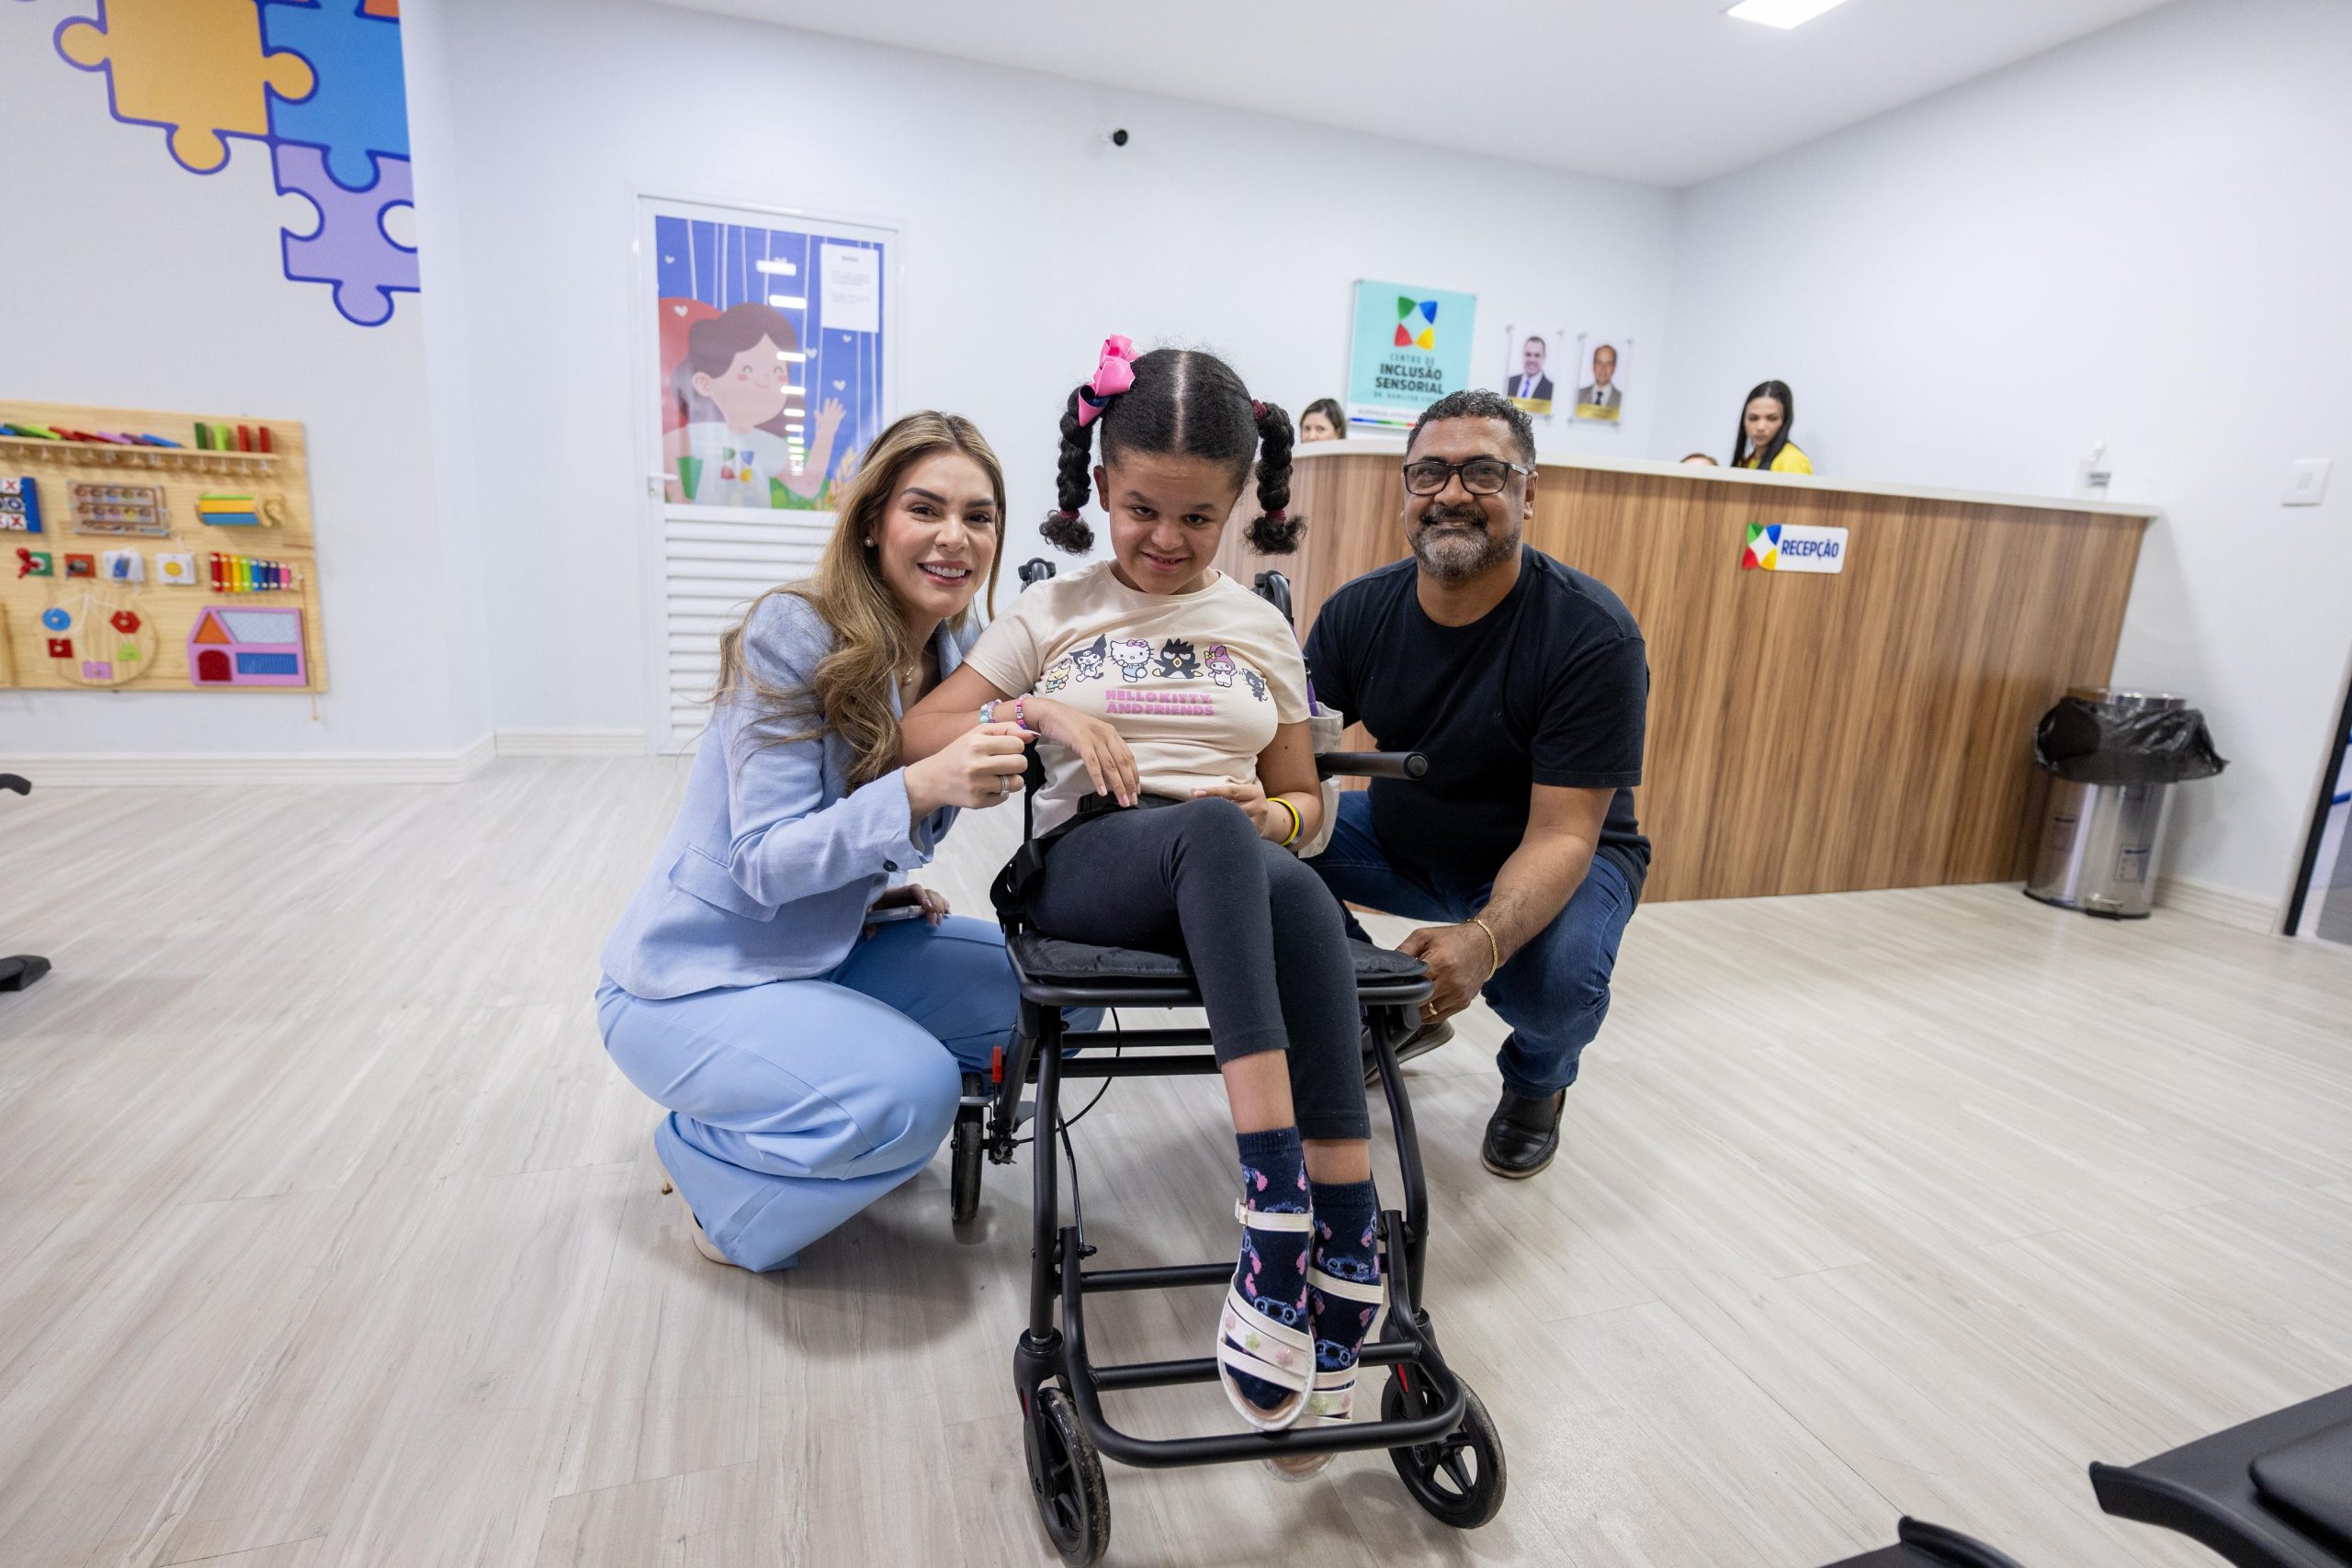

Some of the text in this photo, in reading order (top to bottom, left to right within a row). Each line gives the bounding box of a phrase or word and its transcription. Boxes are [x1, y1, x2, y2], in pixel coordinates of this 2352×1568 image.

[1389, 353, 1435, 366] CENTRO DE
[1380, 363, 1442, 380] INCLUSÃO
[1375, 377, 1444, 394] SENSORIAL
[1781, 539, 1839, 560] RECEPÇÃO
[1105, 690, 1157, 702] HELLO
[1105, 702, 1215, 716] AND FRIENDS
